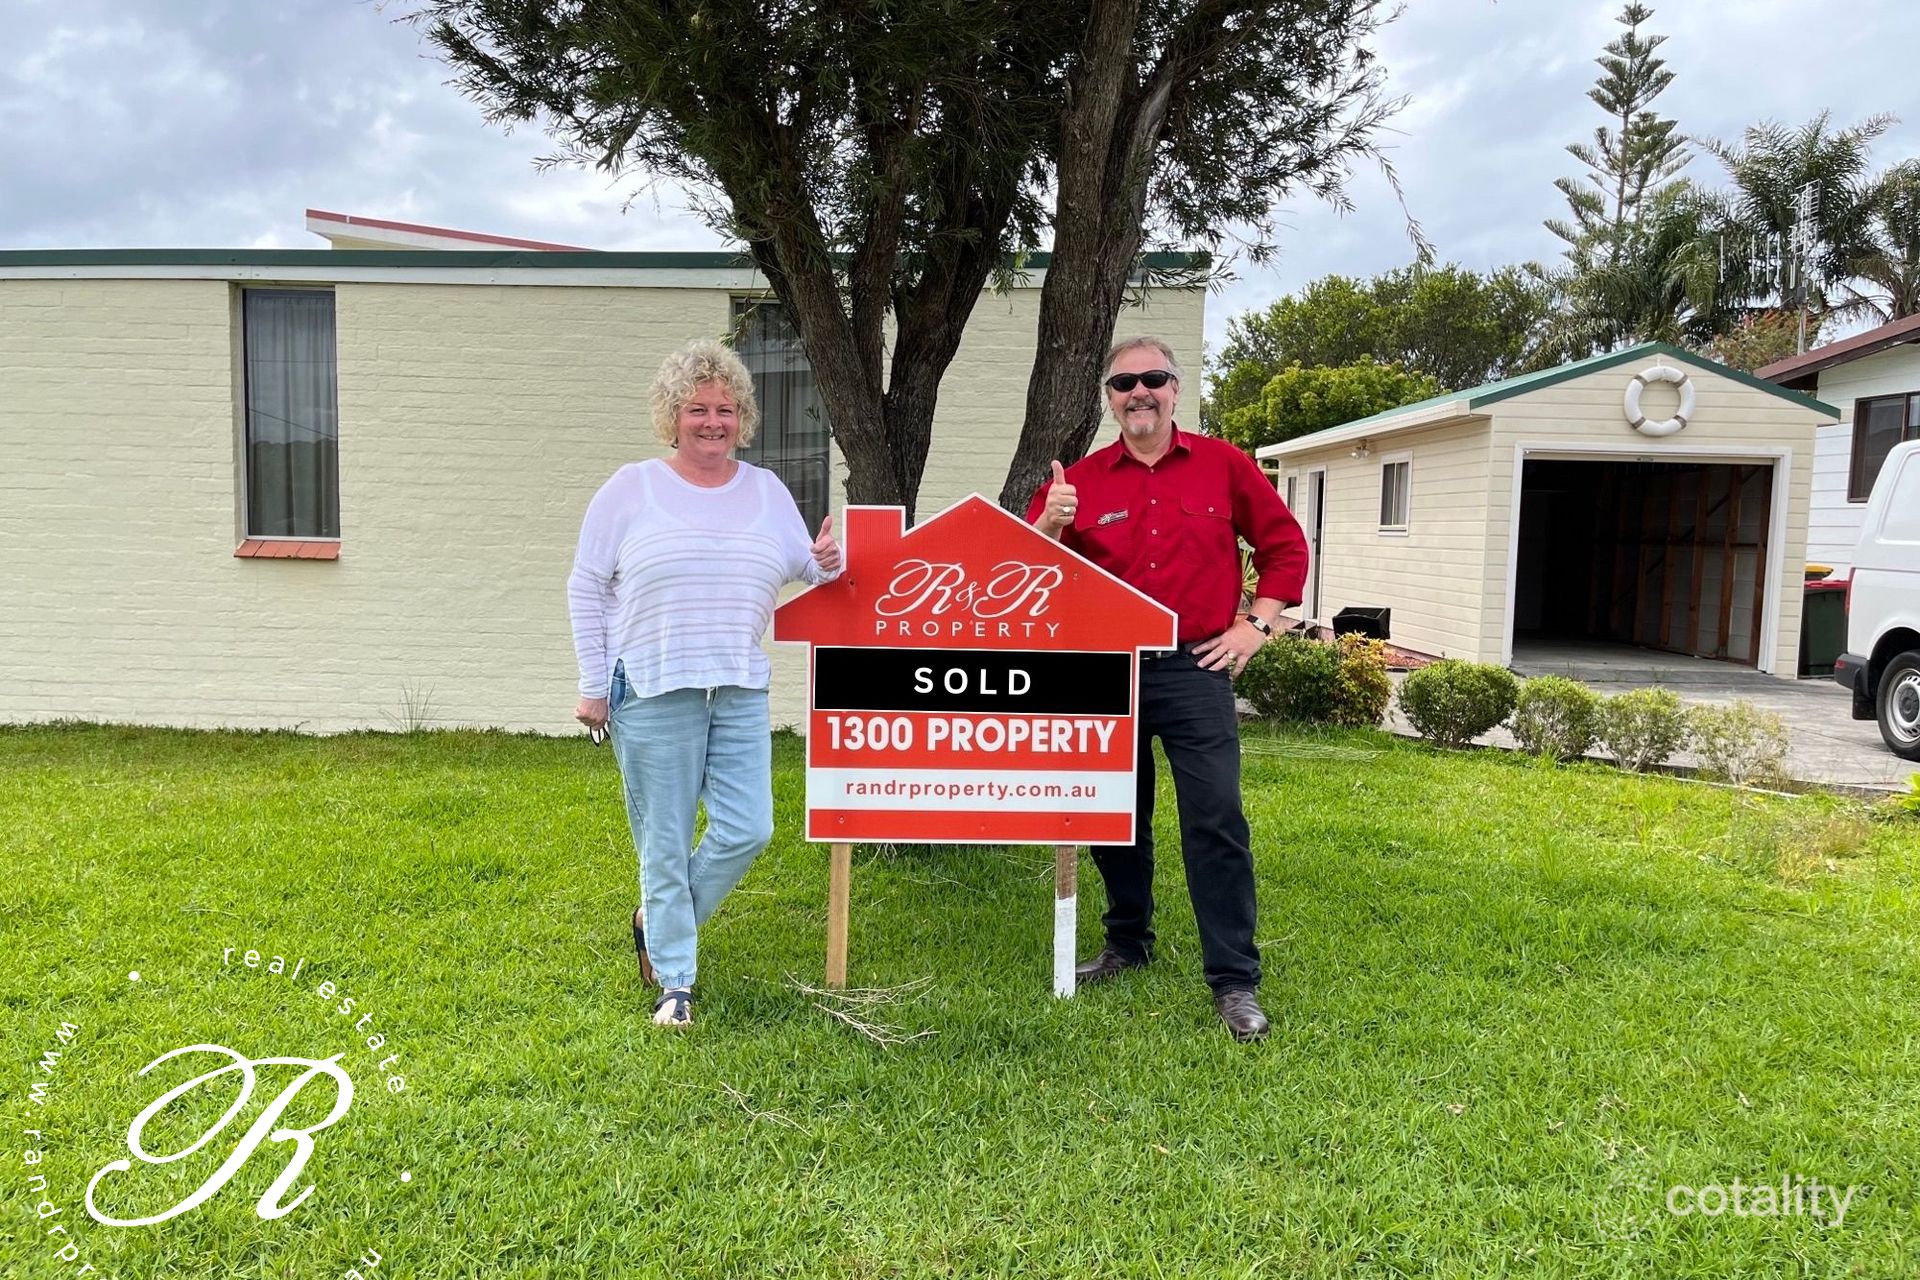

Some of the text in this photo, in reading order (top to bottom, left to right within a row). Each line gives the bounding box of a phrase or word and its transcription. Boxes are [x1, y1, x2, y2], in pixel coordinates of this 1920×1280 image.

[874, 558, 1064, 619] R&R
[875, 620, 1060, 638] PROPERTY
[913, 667, 1032, 696] SOLD
[826, 716, 1117, 753] 1300 PROPERTY
[845, 779, 1097, 801] randrproperty.com.au
